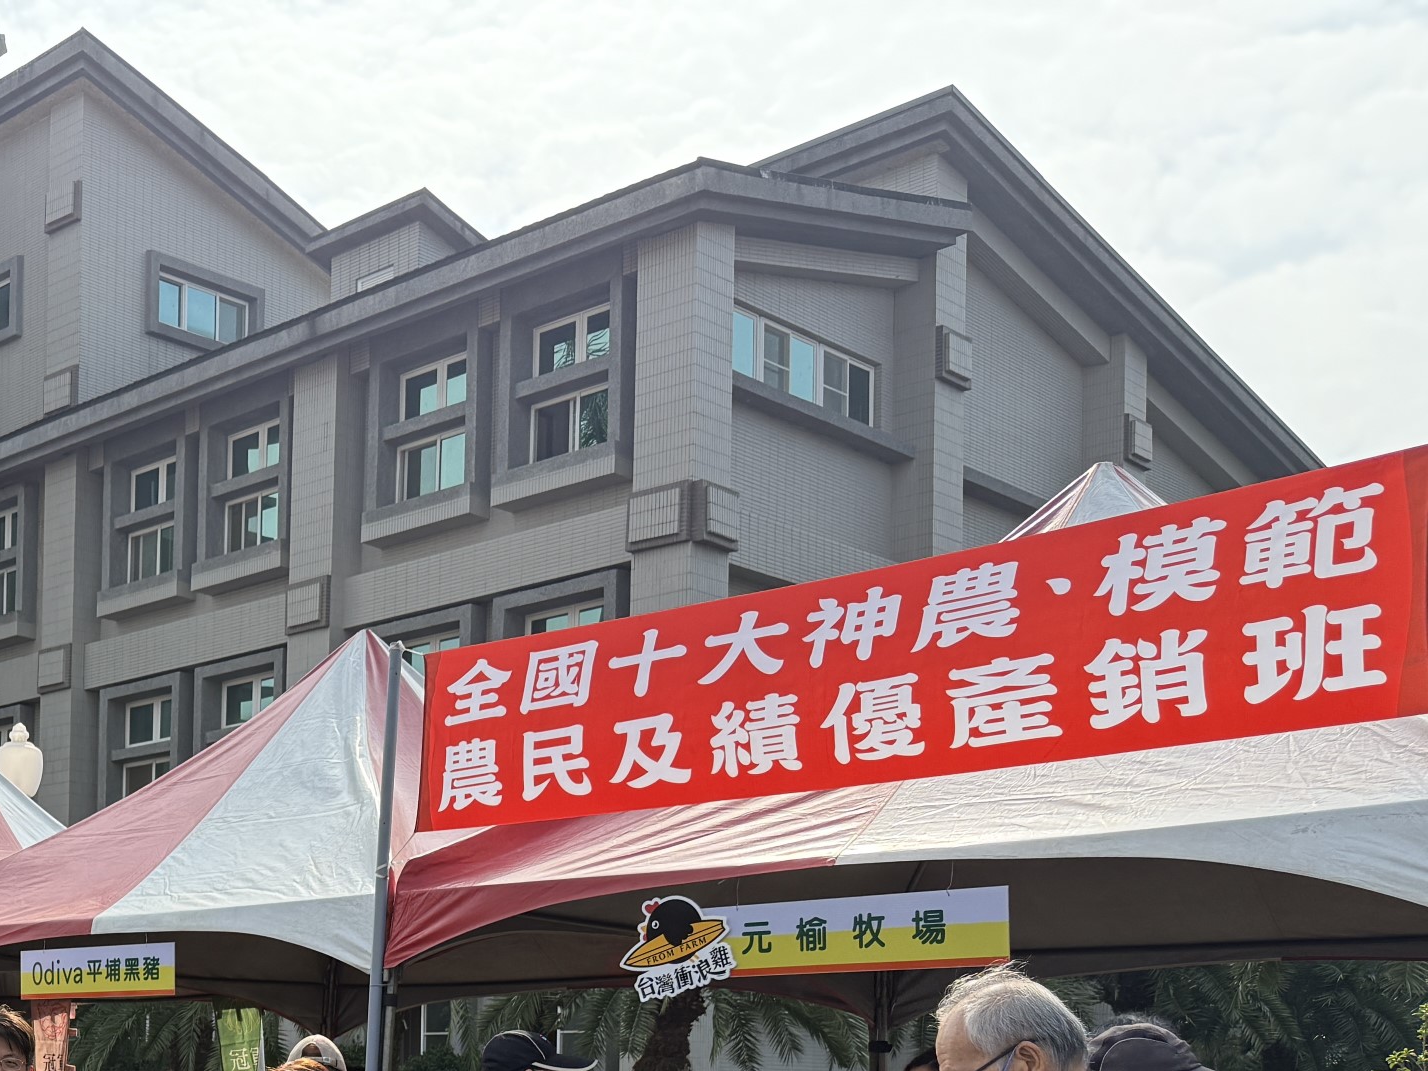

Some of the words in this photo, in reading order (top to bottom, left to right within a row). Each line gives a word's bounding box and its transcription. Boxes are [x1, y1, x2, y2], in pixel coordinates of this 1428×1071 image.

[445, 483, 1385, 727] 全國十大神農、模範
[438, 604, 1388, 812] 農民及績優產銷班
[646, 949, 675, 966] FROM
[679, 936, 707, 953] FARM
[741, 909, 947, 955] 元榆牧場
[637, 945, 732, 999] 台灣衝浪雞
